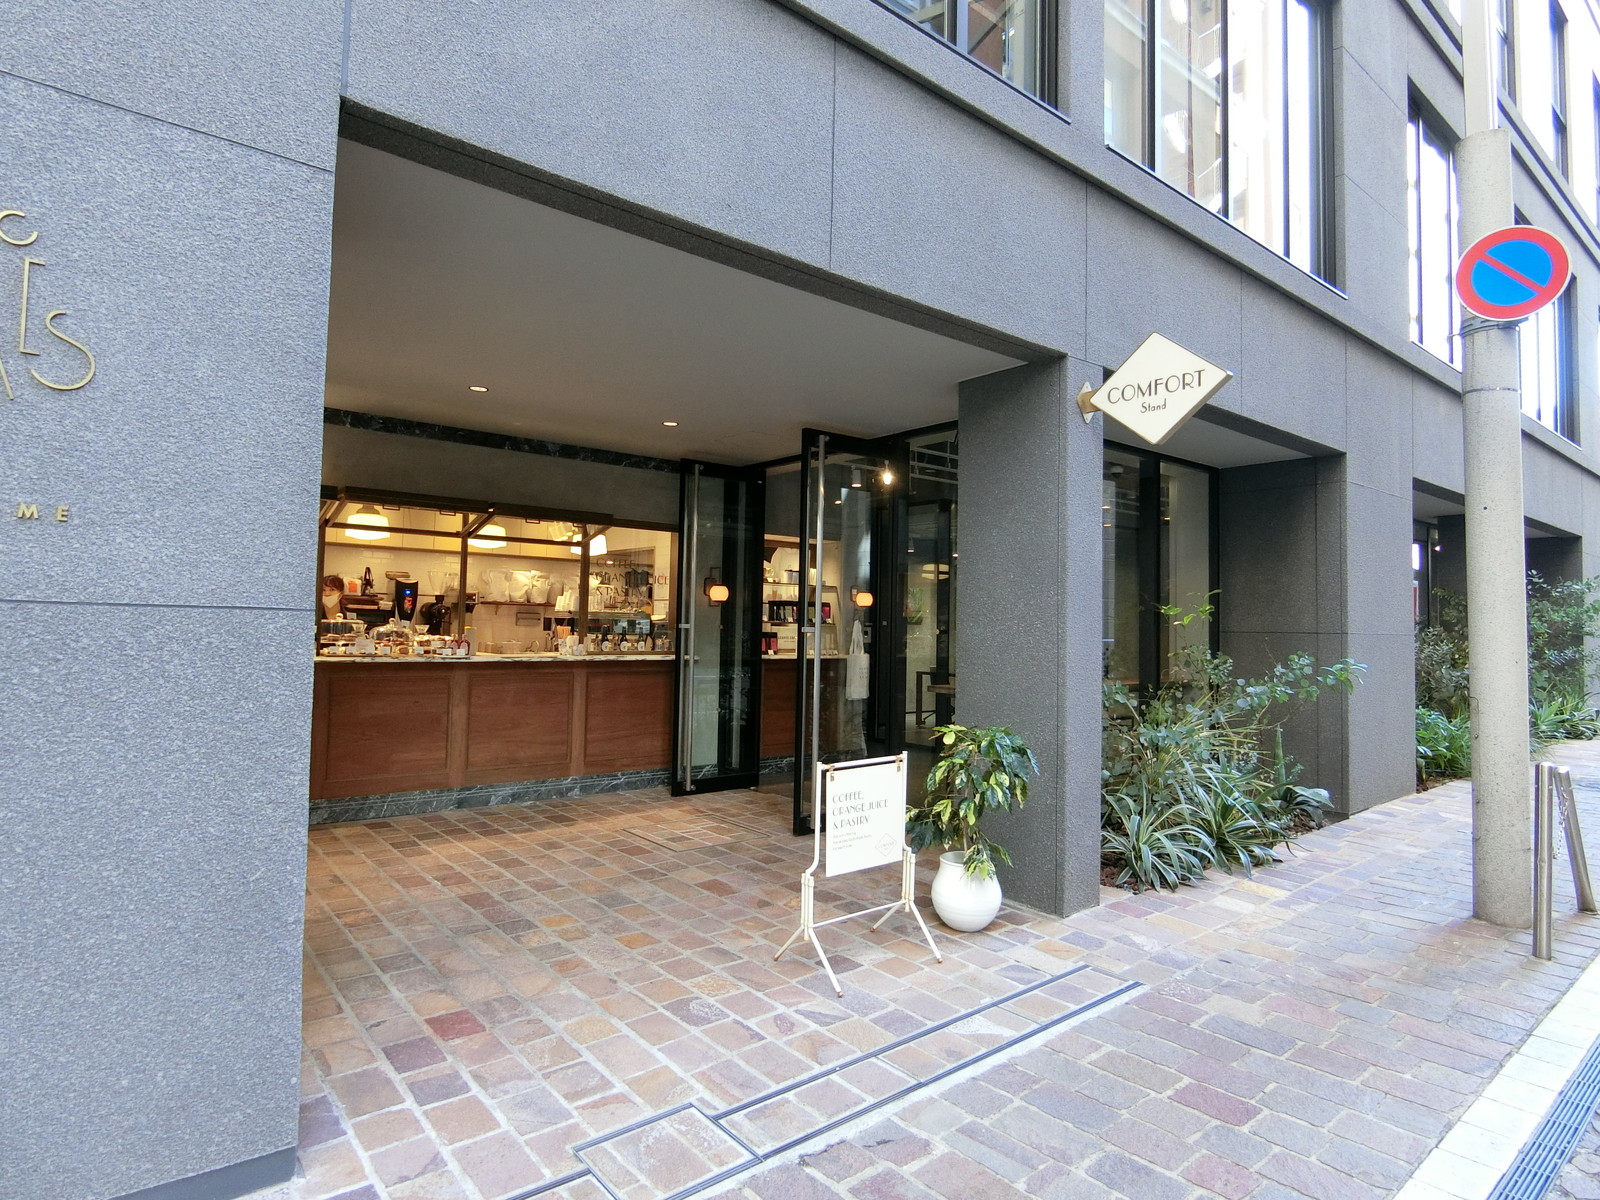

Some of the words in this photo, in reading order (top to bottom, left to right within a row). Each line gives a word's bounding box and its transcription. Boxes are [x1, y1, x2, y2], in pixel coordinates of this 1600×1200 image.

[1107, 368, 1205, 405] COMFORT
[1140, 398, 1167, 414] Stand
[832, 790, 865, 804] COFFEE,
[832, 803, 866, 817] ORANGE
[868, 798, 889, 811] JUICE
[832, 822, 839, 830] &
[840, 815, 871, 829] PASTRY
